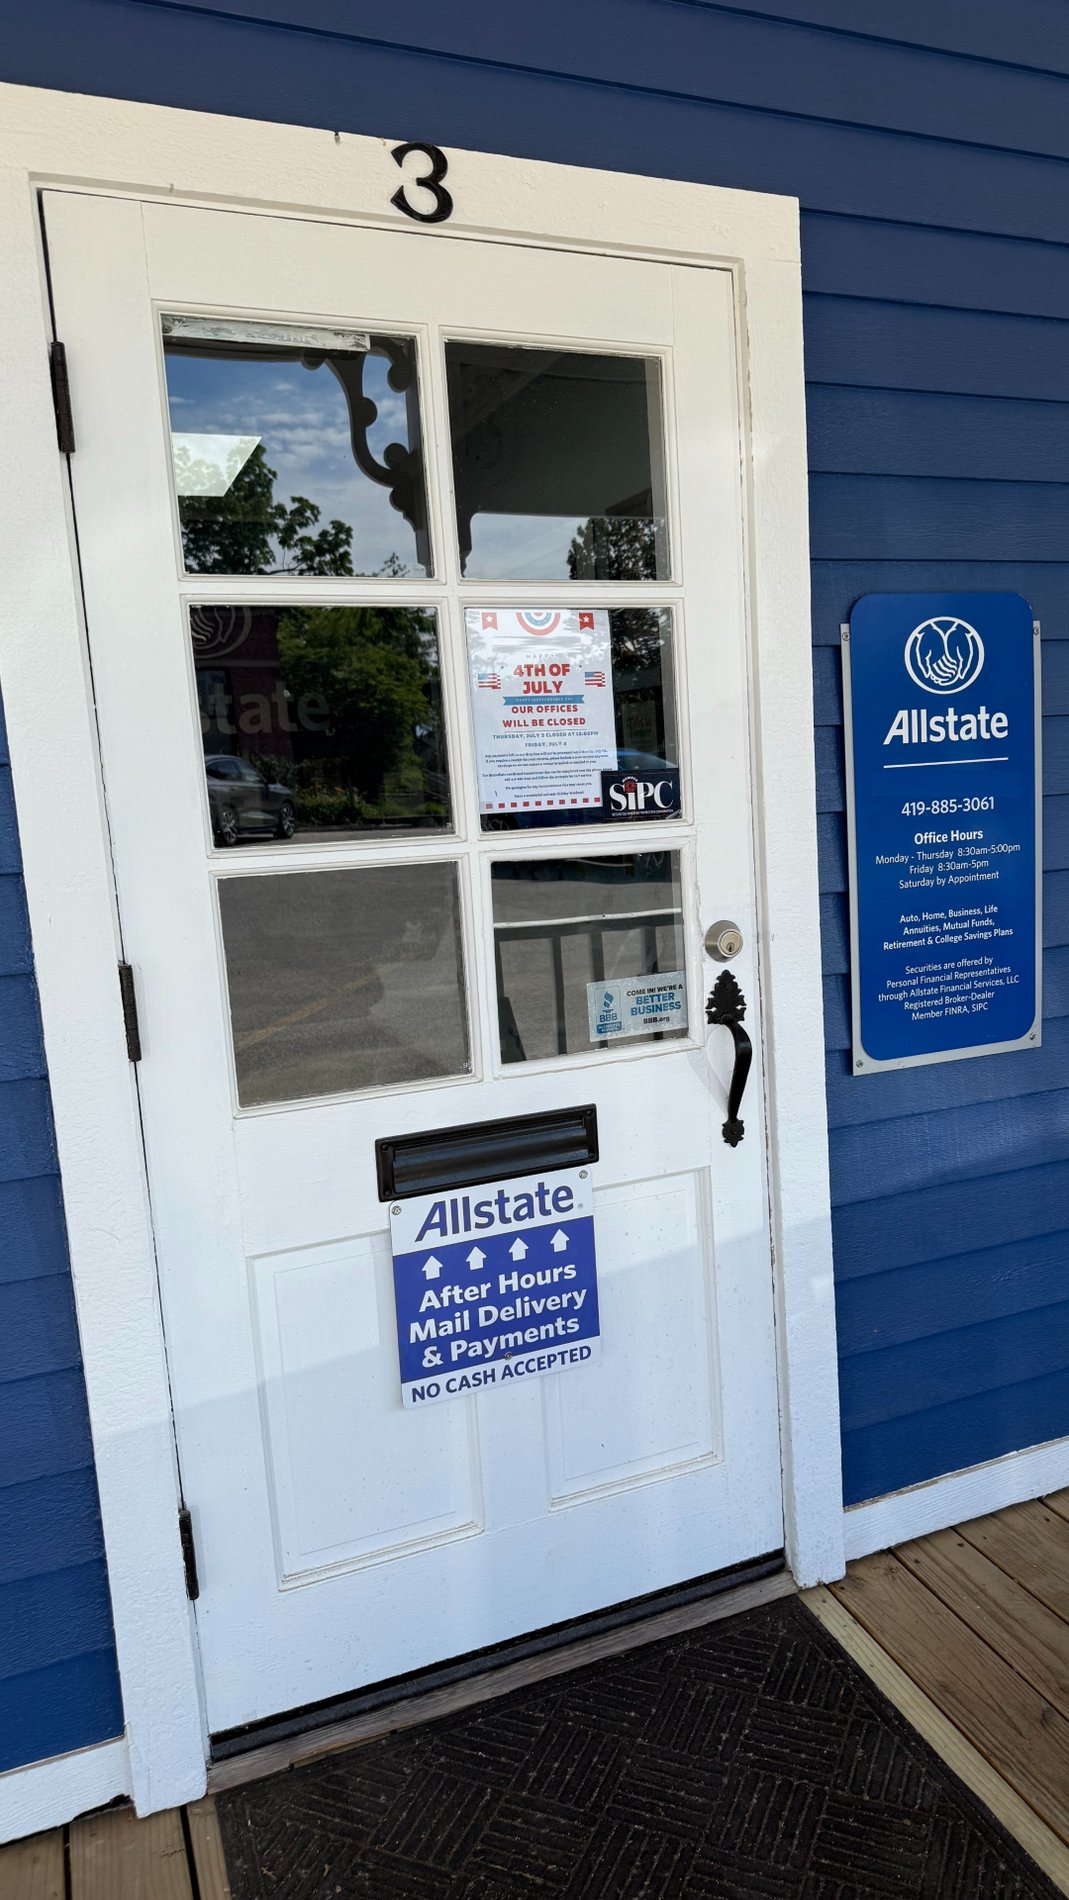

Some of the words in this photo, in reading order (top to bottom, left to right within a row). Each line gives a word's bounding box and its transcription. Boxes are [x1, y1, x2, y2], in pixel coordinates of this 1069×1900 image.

[391, 142, 453, 224] 3
[513, 664, 546, 677] 4TH
[549, 663, 570, 676] OF
[523, 681, 563, 694] JULY
[511, 705, 533, 714] OUR
[536, 704, 578, 713] OFFICES
[502, 720, 529, 728] WILL
[531, 718, 544, 727] BE
[547, 717, 586, 726] CLOSED
[883, 706, 1008, 745] Allstate
[901, 796, 995, 816] 419-885-3061
[914, 832, 948, 845] Office
[951, 829, 984, 842] Hours
[875, 854, 910, 865] Monday
[916, 850, 954, 861] Thursday
[957, 843, 1021, 857] 8:30am-5:00pm
[909, 865, 934, 875] Friday
[938, 859, 989, 872] 8:30am-5pm
[899, 878, 935, 889] Saturday
[936, 876, 946, 887] by
[948, 870, 1000, 885] Appointment
[900, 914, 921, 923] Auto,
[922, 912, 947, 921] Home,
[948, 907, 983, 918] Business,
[984, 904, 998, 914] Life
[903, 924, 942, 935] Annuities,
[943, 919, 970, 931] Mutual
[971, 917, 995, 927] Funds,
[883, 939, 926, 950] Retirement
[927, 937, 933, 945] &
[935, 934, 963, 944] College
[964, 930, 992, 941] Savings
[993, 928, 1014, 937] Plans
[905, 963, 942, 975] Securities
[943, 962, 955, 970] are
[956, 956, 983, 968] offered
[984, 955, 994, 965] by
[886, 976, 919, 989] Personal
[920, 972, 953, 984] Financial
[954, 965, 1012, 980] Representatives
[626, 988, 646, 997] COME
[657, 984, 677, 993] WE'RE
[878, 990, 908, 1002] through
[909, 986, 939, 998] Allstate
[940, 981, 972, 993] Financial
[973, 977, 1006, 989] Services,
[1006, 974, 1020, 984] LLC
[636, 992, 675, 1005] BETTER
[904, 997, 943, 1010] Registered
[944, 990, 995, 1004] Broker-Dealer
[599, 1013, 618, 1023] BBB
[630, 1001, 682, 1016] BUSINESS
[911, 1009, 943, 1021] Member
[944, 1005, 970, 1016] FINRA,
[971, 1002, 989, 1012] SIPC
[643, 1016, 670, 1024] BBB.org
[419, 1281, 491, 1313] After
[499, 1264, 577, 1294] Hours
[409, 1310, 470, 1344] Mail
[479, 1289, 587, 1327] Delivery
[422, 1346, 444, 1368] &
[451, 1317, 580, 1361] Payments
[412, 1382, 441, 1403] NO
[446, 1368, 496, 1393] CASH
[501, 1345, 592, 1380] ACCEPTED
